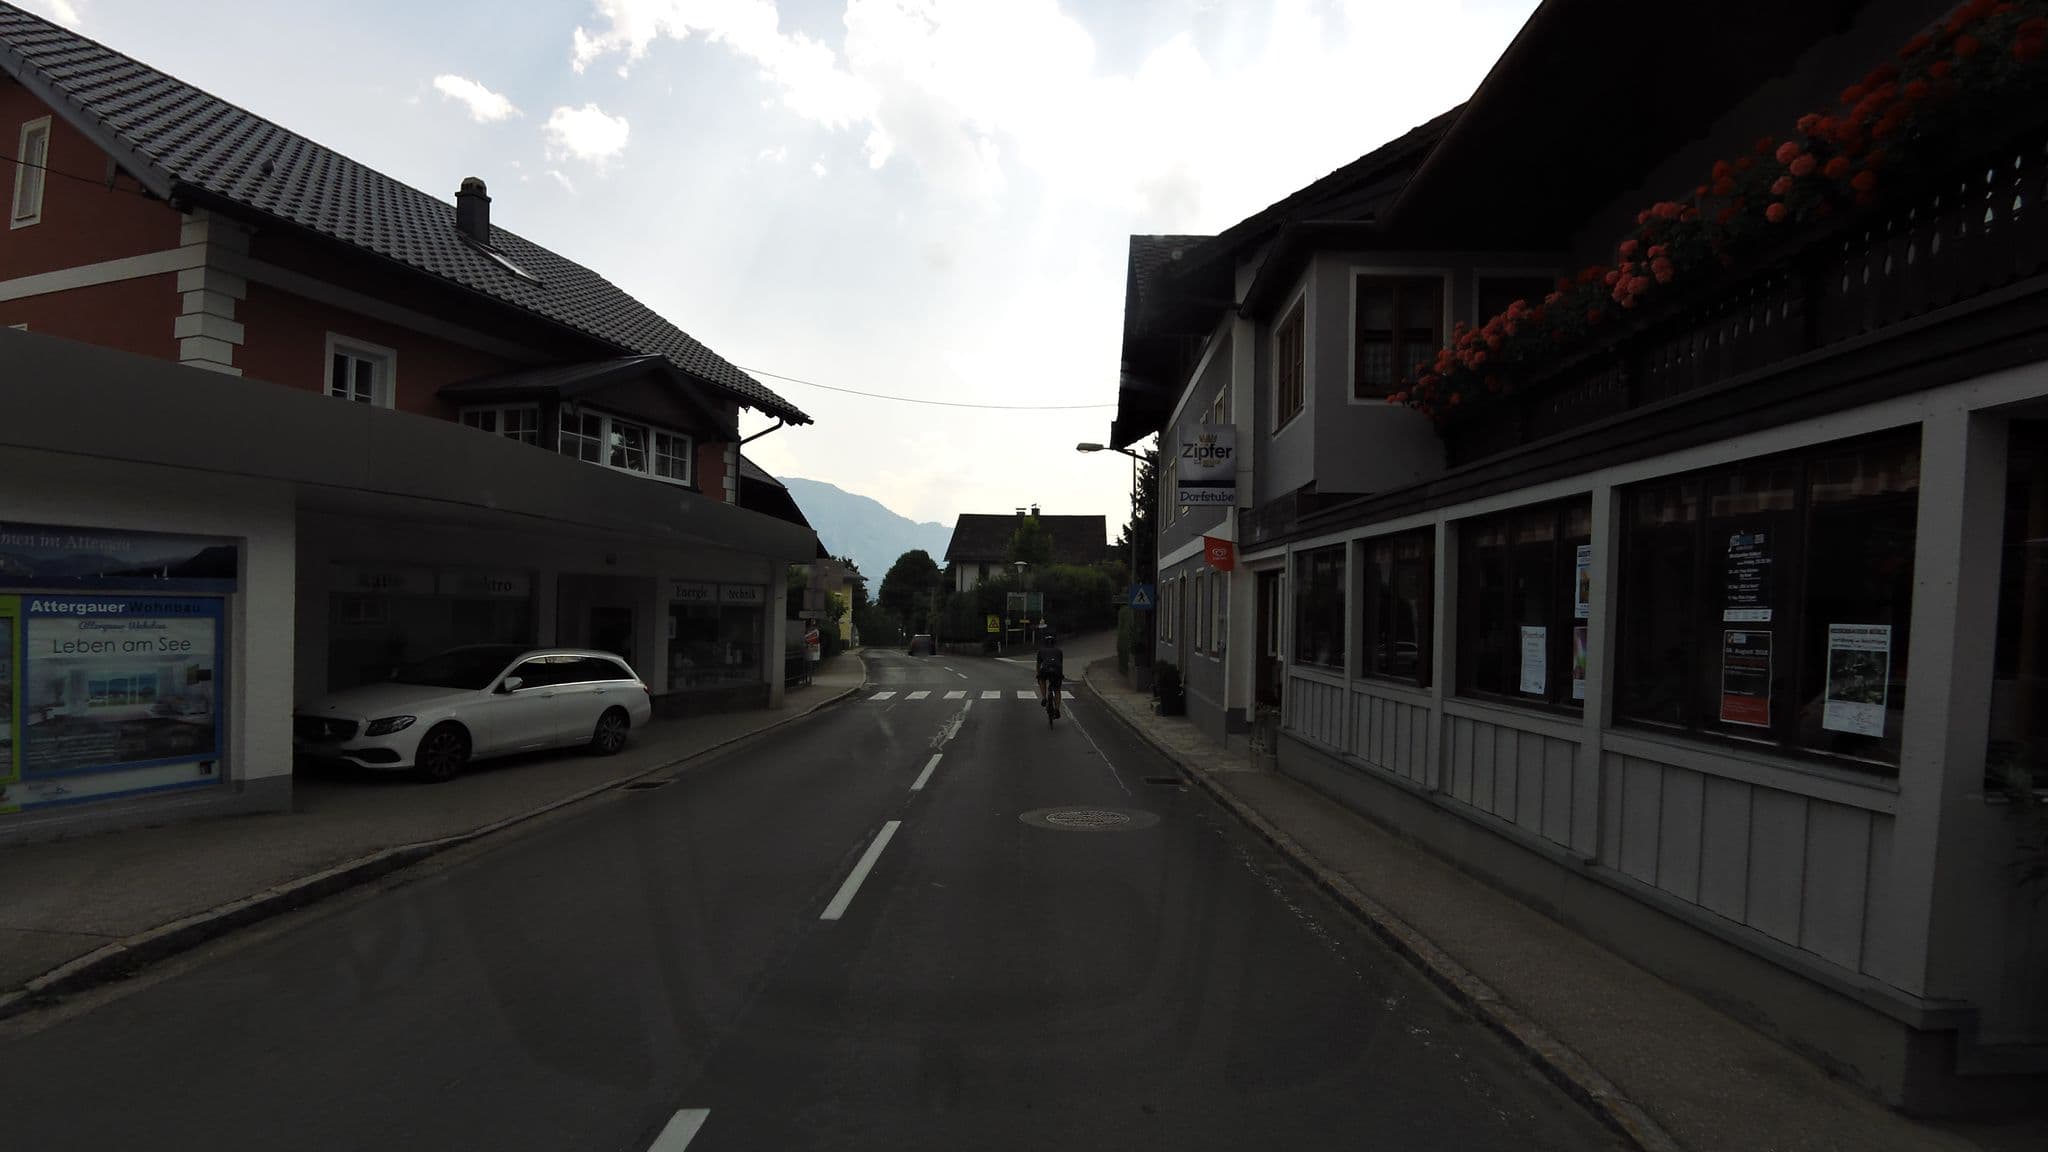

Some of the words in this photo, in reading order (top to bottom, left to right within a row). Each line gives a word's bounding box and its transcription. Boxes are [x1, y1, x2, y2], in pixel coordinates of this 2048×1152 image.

[1182, 443, 1233, 461] Zipfer
[1180, 490, 1234, 502] Dorfstube
[30, 600, 125, 615] Attergauer
[129, 601, 201, 613] Wohnbau
[53, 638, 116, 654] Leben
[122, 640, 153, 652] am
[158, 636, 192, 652] See
